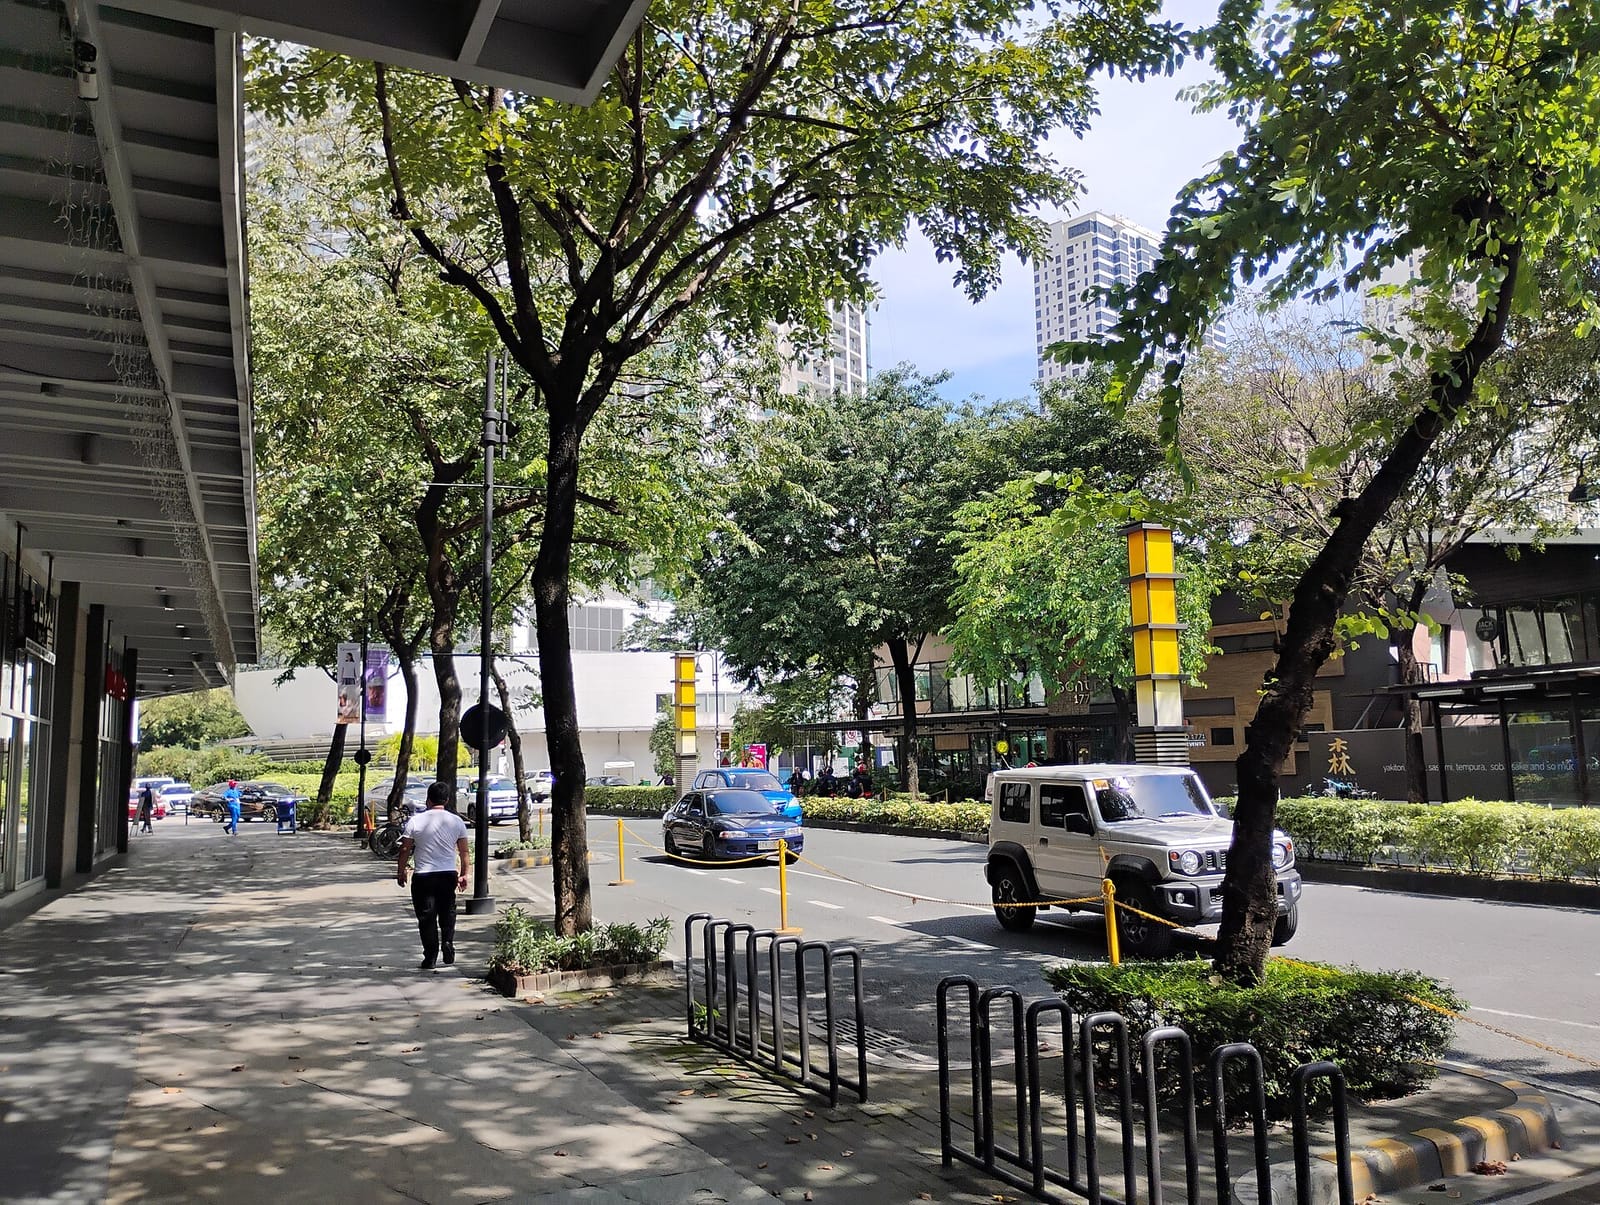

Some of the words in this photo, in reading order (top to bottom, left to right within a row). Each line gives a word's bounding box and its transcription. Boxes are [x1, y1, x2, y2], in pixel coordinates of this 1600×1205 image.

[1328, 737, 1356, 775] 森
[1530, 763, 1544, 771] and
[1557, 763, 1574, 772] muc
